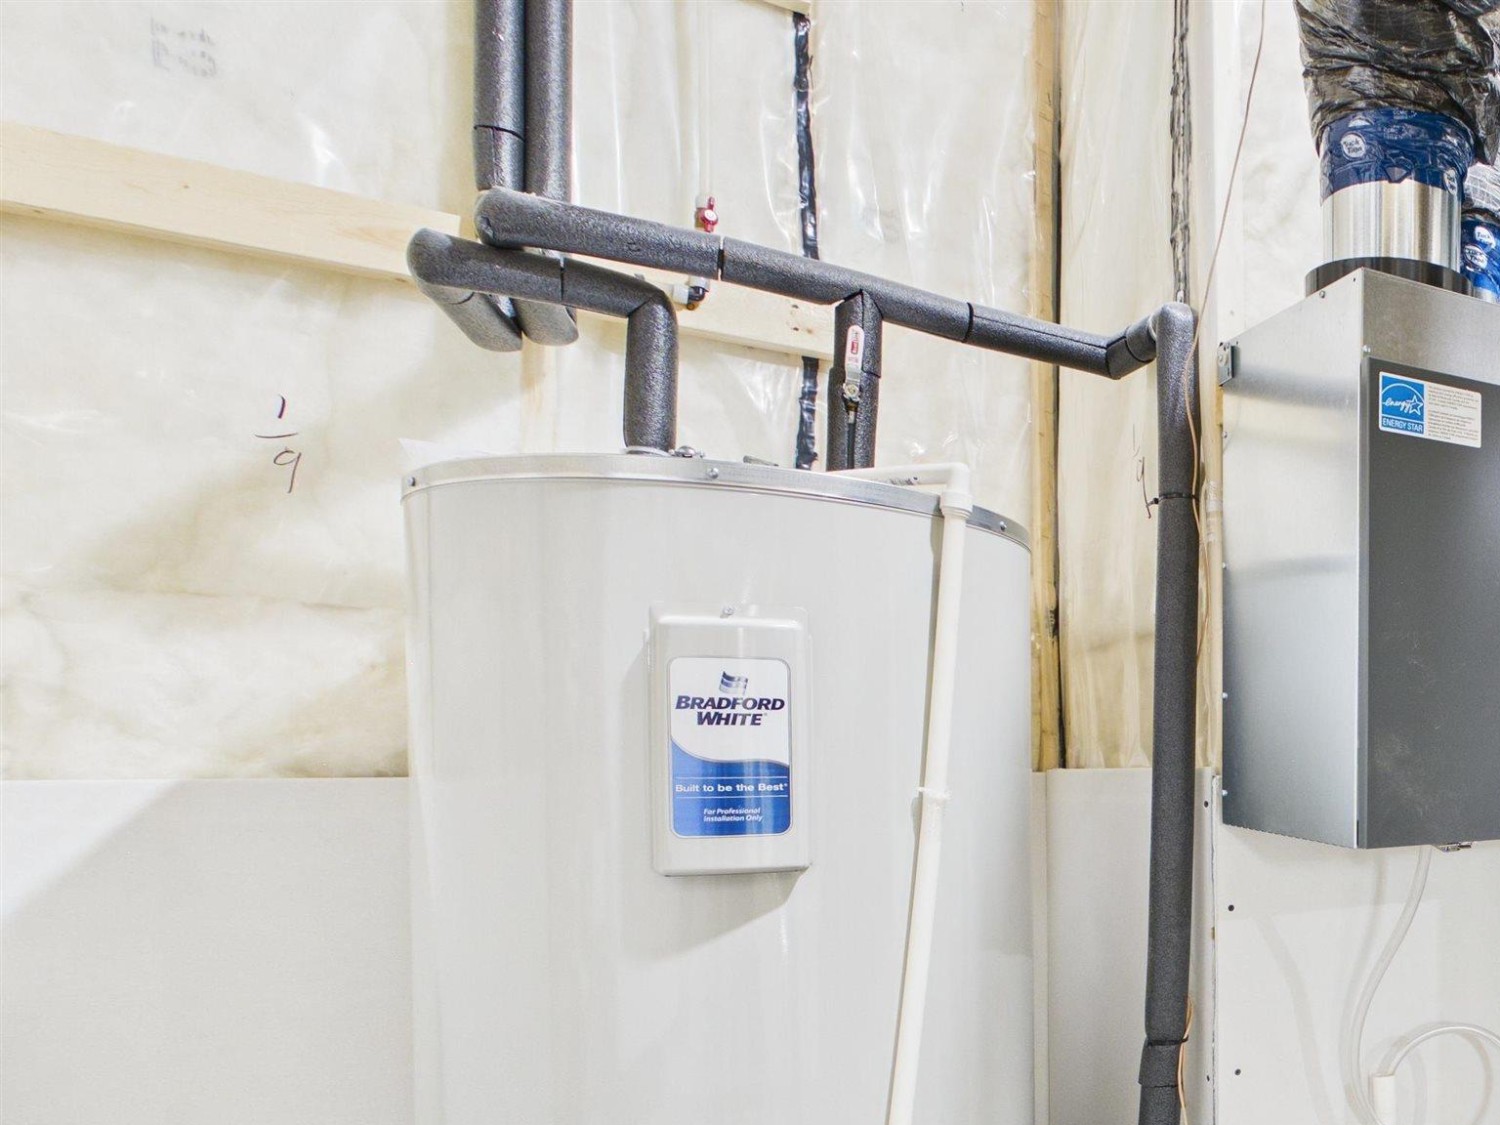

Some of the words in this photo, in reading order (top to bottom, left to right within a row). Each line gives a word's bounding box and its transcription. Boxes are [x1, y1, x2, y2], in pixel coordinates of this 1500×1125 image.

[1382, 418, 1406, 430] ENERGY
[1407, 422, 1423, 432] STAR
[675, 695, 785, 711] BRADFORD
[696, 711, 764, 726] WHITE
[675, 782, 700, 792] Built
[702, 784, 714, 792] to
[717, 783, 733, 792] be
[736, 783, 754, 792] the
[716, 807, 761, 815] Professional
[703, 814, 745, 822] Installation
[746, 814, 764, 823] Only
